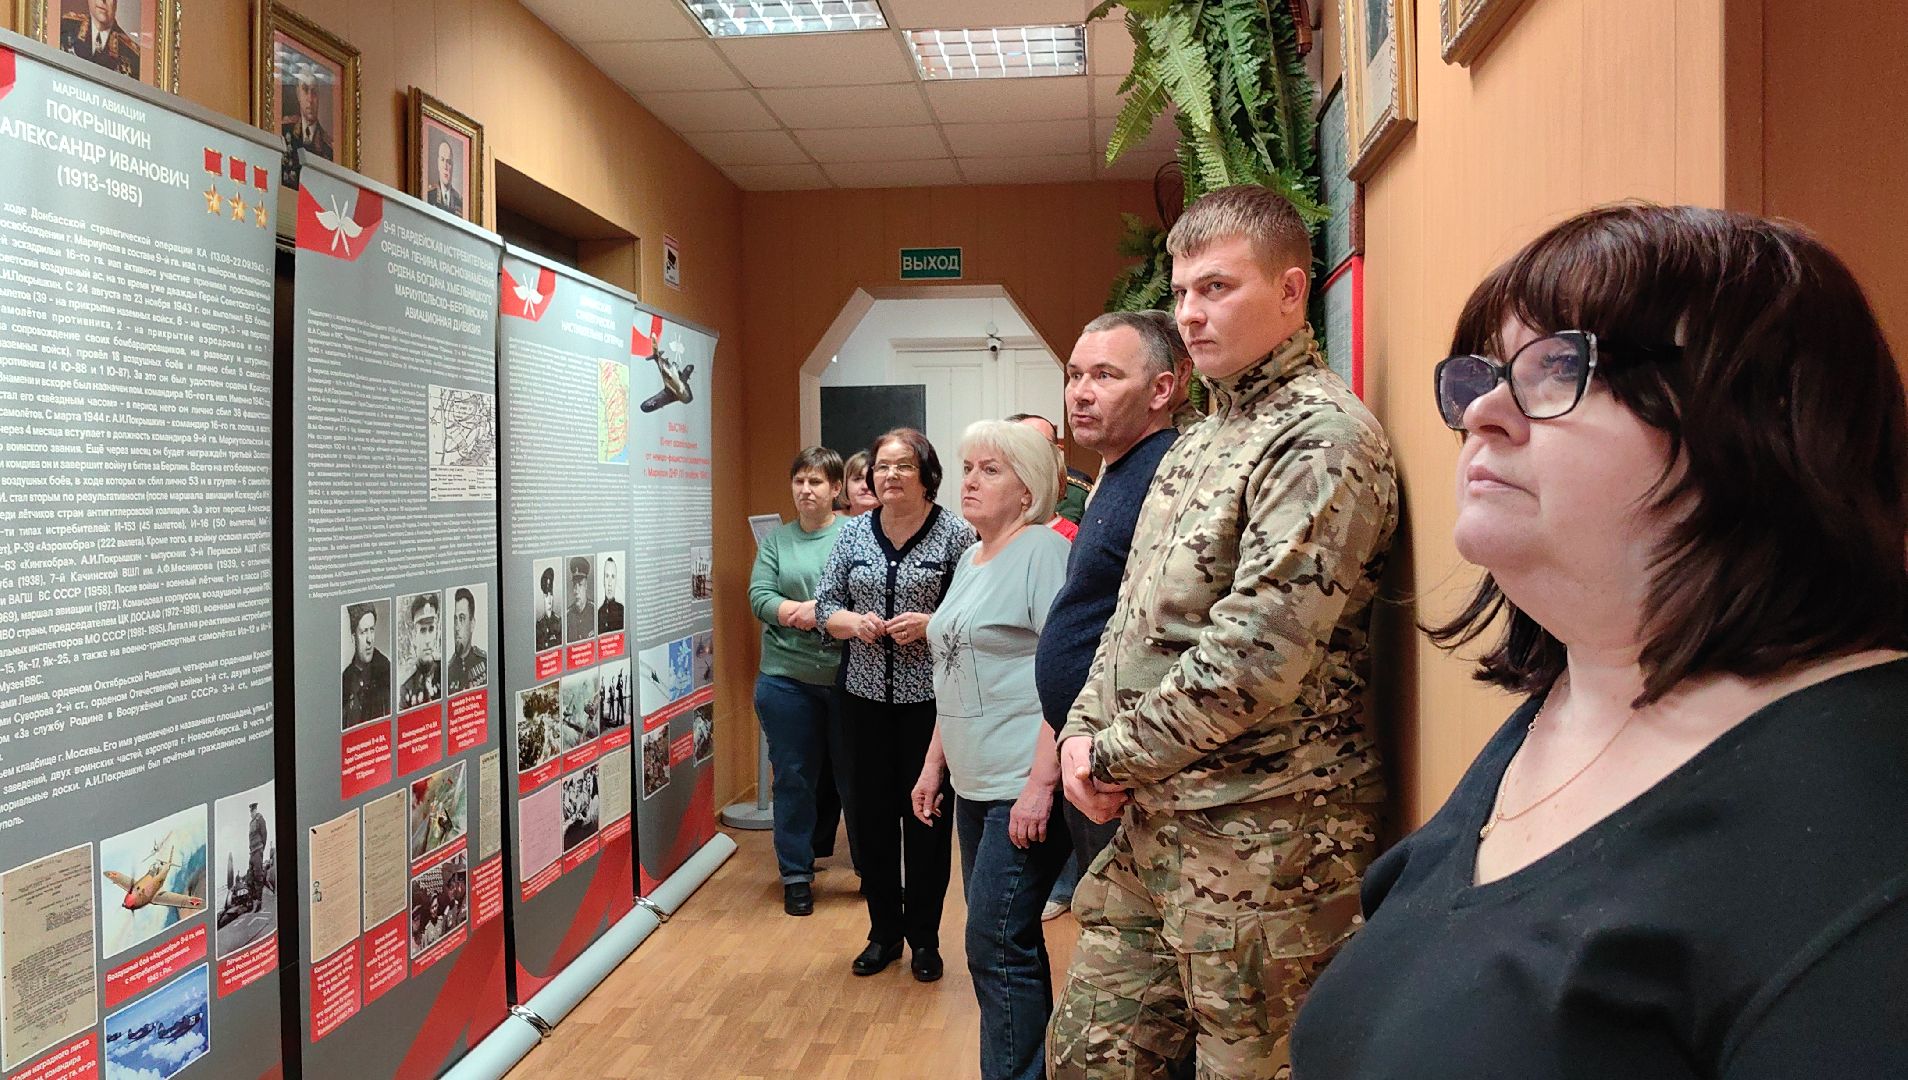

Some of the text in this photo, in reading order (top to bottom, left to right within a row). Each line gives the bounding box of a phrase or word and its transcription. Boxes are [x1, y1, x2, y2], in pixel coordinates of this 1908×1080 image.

[53, 80, 146, 122] МАРШАЛ АВИАЦИИ
[47, 99, 151, 150] ПОКРЫШКИН
[0, 117, 190, 189] АЛЕКСАНДР ИВАНОВИЧ
[57, 165, 143, 207] (1913-1985)
[3, 202, 26, 215] ходе
[31, 207, 85, 228] Донбасской
[90, 224, 150, 244] стратегической
[381, 240, 409, 259] ОРДЕНА
[40, 262, 90, 277] воздушный
[388, 262, 416, 281] ОРДЕНА
[903, 255, 959, 270] ВЫХОД
[68, 300, 115, 313] прикрытие
[91, 287, 120, 299] августа
[173, 300, 192, 312] 1943
[11, 324, 109, 344] сопровождение своих
[52, 313, 112, 329] противника,
[147, 328, 193, 341] прикрытие
[60, 361, 87, 373] Ю-88
[170, 374, 186, 383] был
[19, 392, 34, 401] его
[41, 378, 183, 399] вскоре был командира
[53, 411, 209, 430] марта 1944 командир
[32, 427, 63, 436] месяца
[64, 428, 104, 439] вступает
[112, 431, 150, 440] должность
[151, 433, 191, 443] командира
[193, 433, 206, 442] 9-й
[6, 443, 48, 451] воинского
[50, 444, 82, 453] звания.
[85, 443, 104, 454] Ещё
[106, 446, 128, 455] через
[163, 446, 184, 458] будет
[60, 460, 102, 470] завершит
[1, 477, 47, 487] воздушных
[82, 477, 103, 486] ходе
[105, 477, 136, 486] которых
[29, 493, 60, 503] вторым
[76, 492, 144, 503] результативности
[56, 509, 83, 519] стран
[87, 506, 153, 517] антигитлеровской
[18, 527, 41, 535] типах
[45, 523, 110, 535] истребителей:
[114, 521, 135, 531] И-153
[190, 518, 208, 528] И-16
[13, 537, 115, 553] Р-39 «Аэрокобра» (222
[81, 553, 141, 564] А.И.Покрышкин
[49, 572, 65, 583] 7-й
[70, 569, 117, 581] Качинской
[8, 592, 32, 604] ВАГШ
[52, 587, 81, 599] СССР
[84, 584, 111, 598] (1958).
[55, 605, 92, 615] авиации
[94, 599, 120, 612] (1972).
[48, 617, 116, 633] председателем
[28, 629, 126, 652] инспекторов МО СССР
[81, 649, 107, 660] также
[52, 684, 92, 698] орденом
[93, 673, 143, 689] Октябрьской
[13, 679, 178, 723] Суворова 2-й орденом Отечественной
[33, 719, 64, 735] службу
[69, 713, 103, 726] Родине
[15, 755, 56, 772] кладбище
[65, 746, 101, 759] Москвы.
[102, 741, 117, 751] Его
[50, 768, 71, 781] двух
[74, 758, 113, 774] воинских
[52, 765, 144, 797] доски. А.И.Покрышкин
[32, 1039, 90, 1073] наградного листа
[45, 1055, 81, 1078] командира
